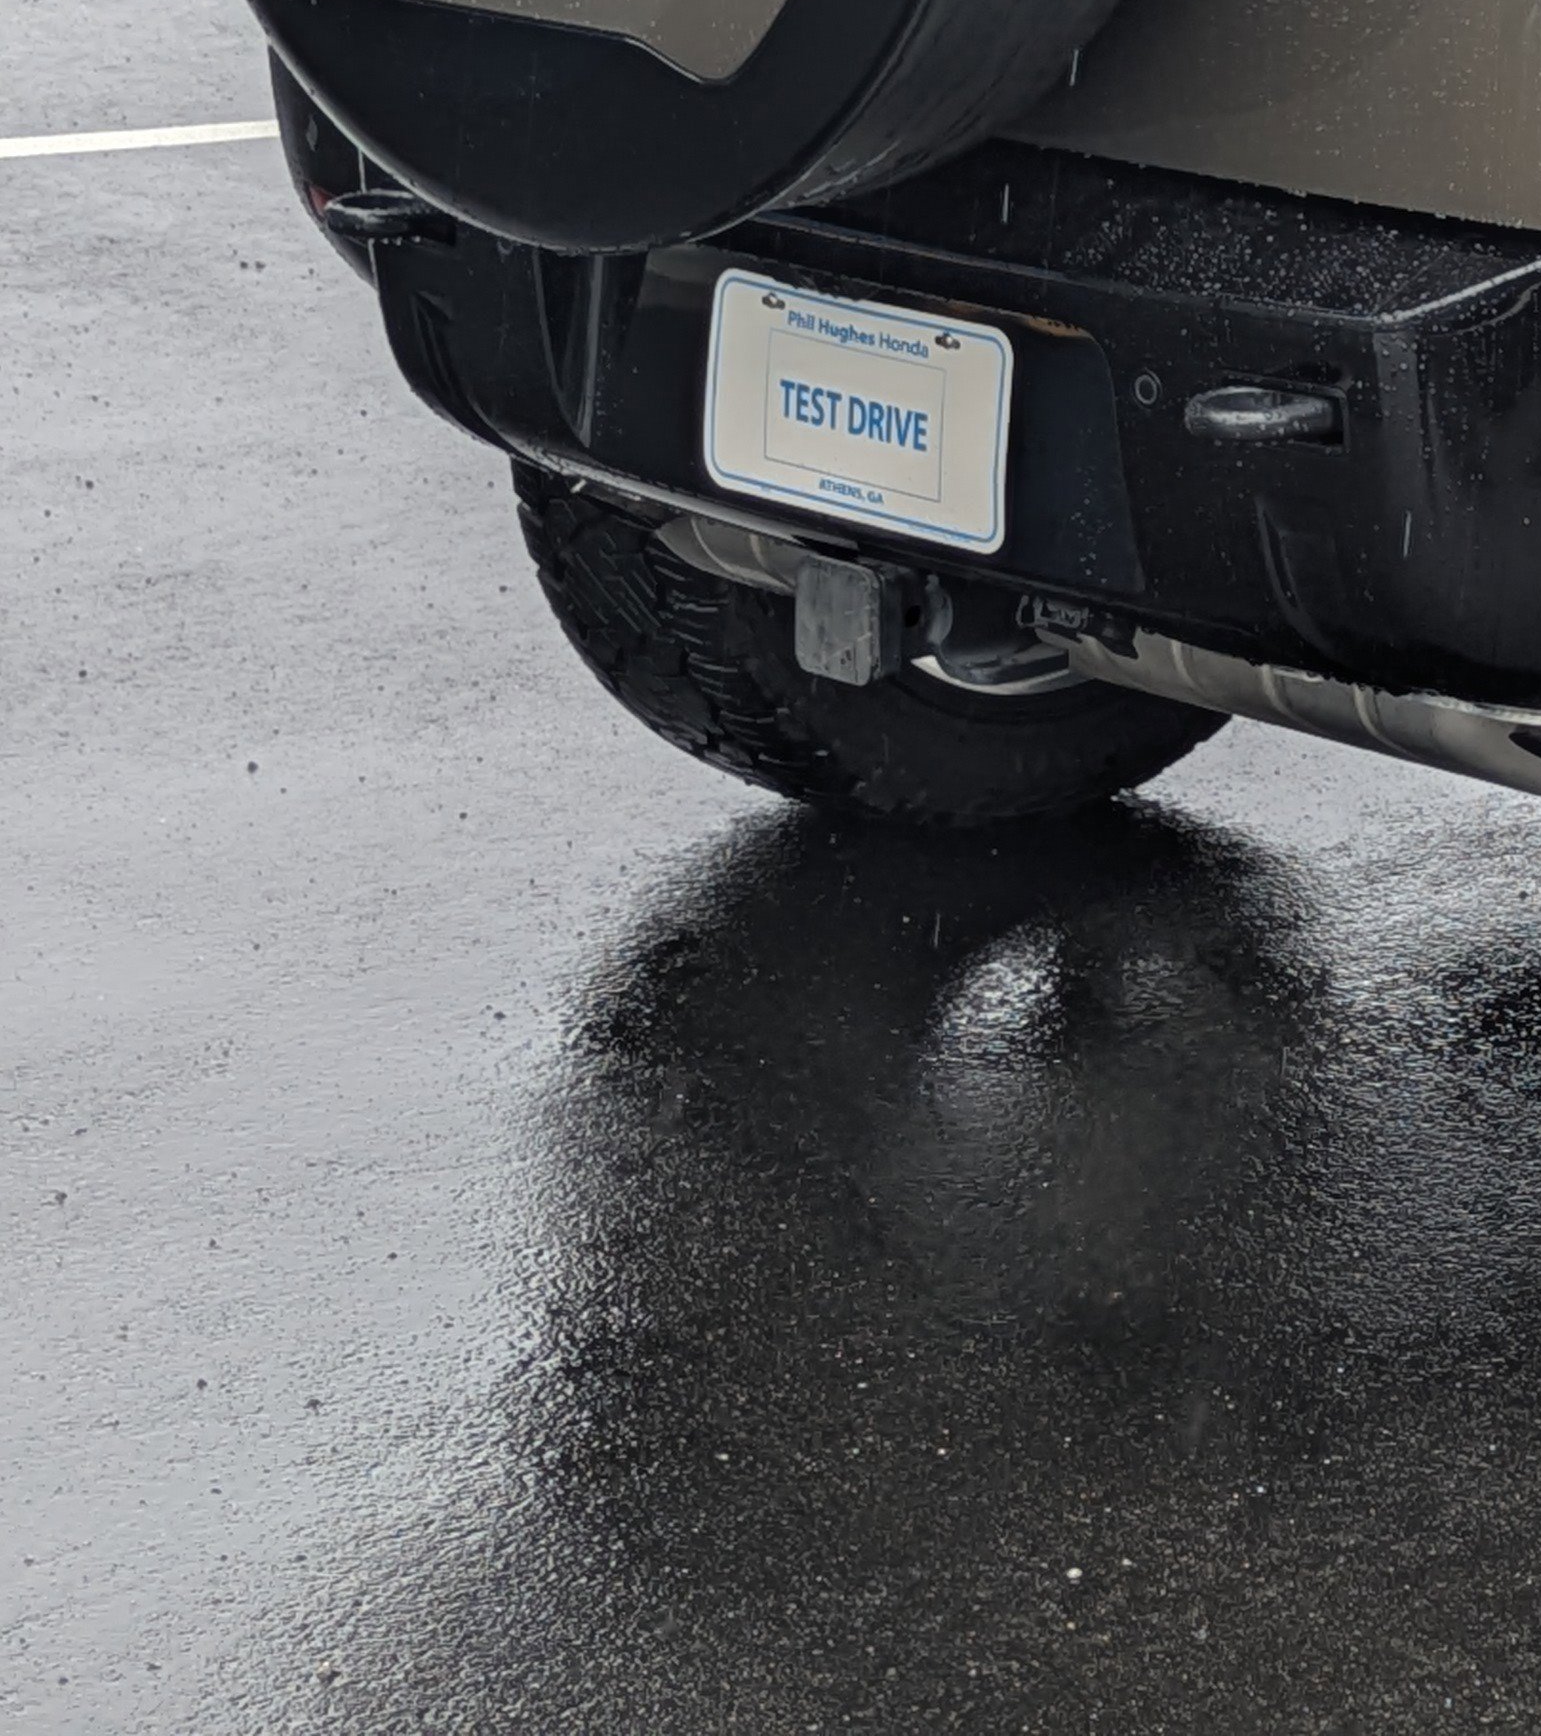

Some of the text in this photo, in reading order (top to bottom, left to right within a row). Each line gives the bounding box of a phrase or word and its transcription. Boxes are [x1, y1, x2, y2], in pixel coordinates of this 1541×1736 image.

[787, 310, 930, 359] Phil Hughes Honda
[779, 378, 928, 452] TEST DRIVE
[867, 490, 885, 505] GA
